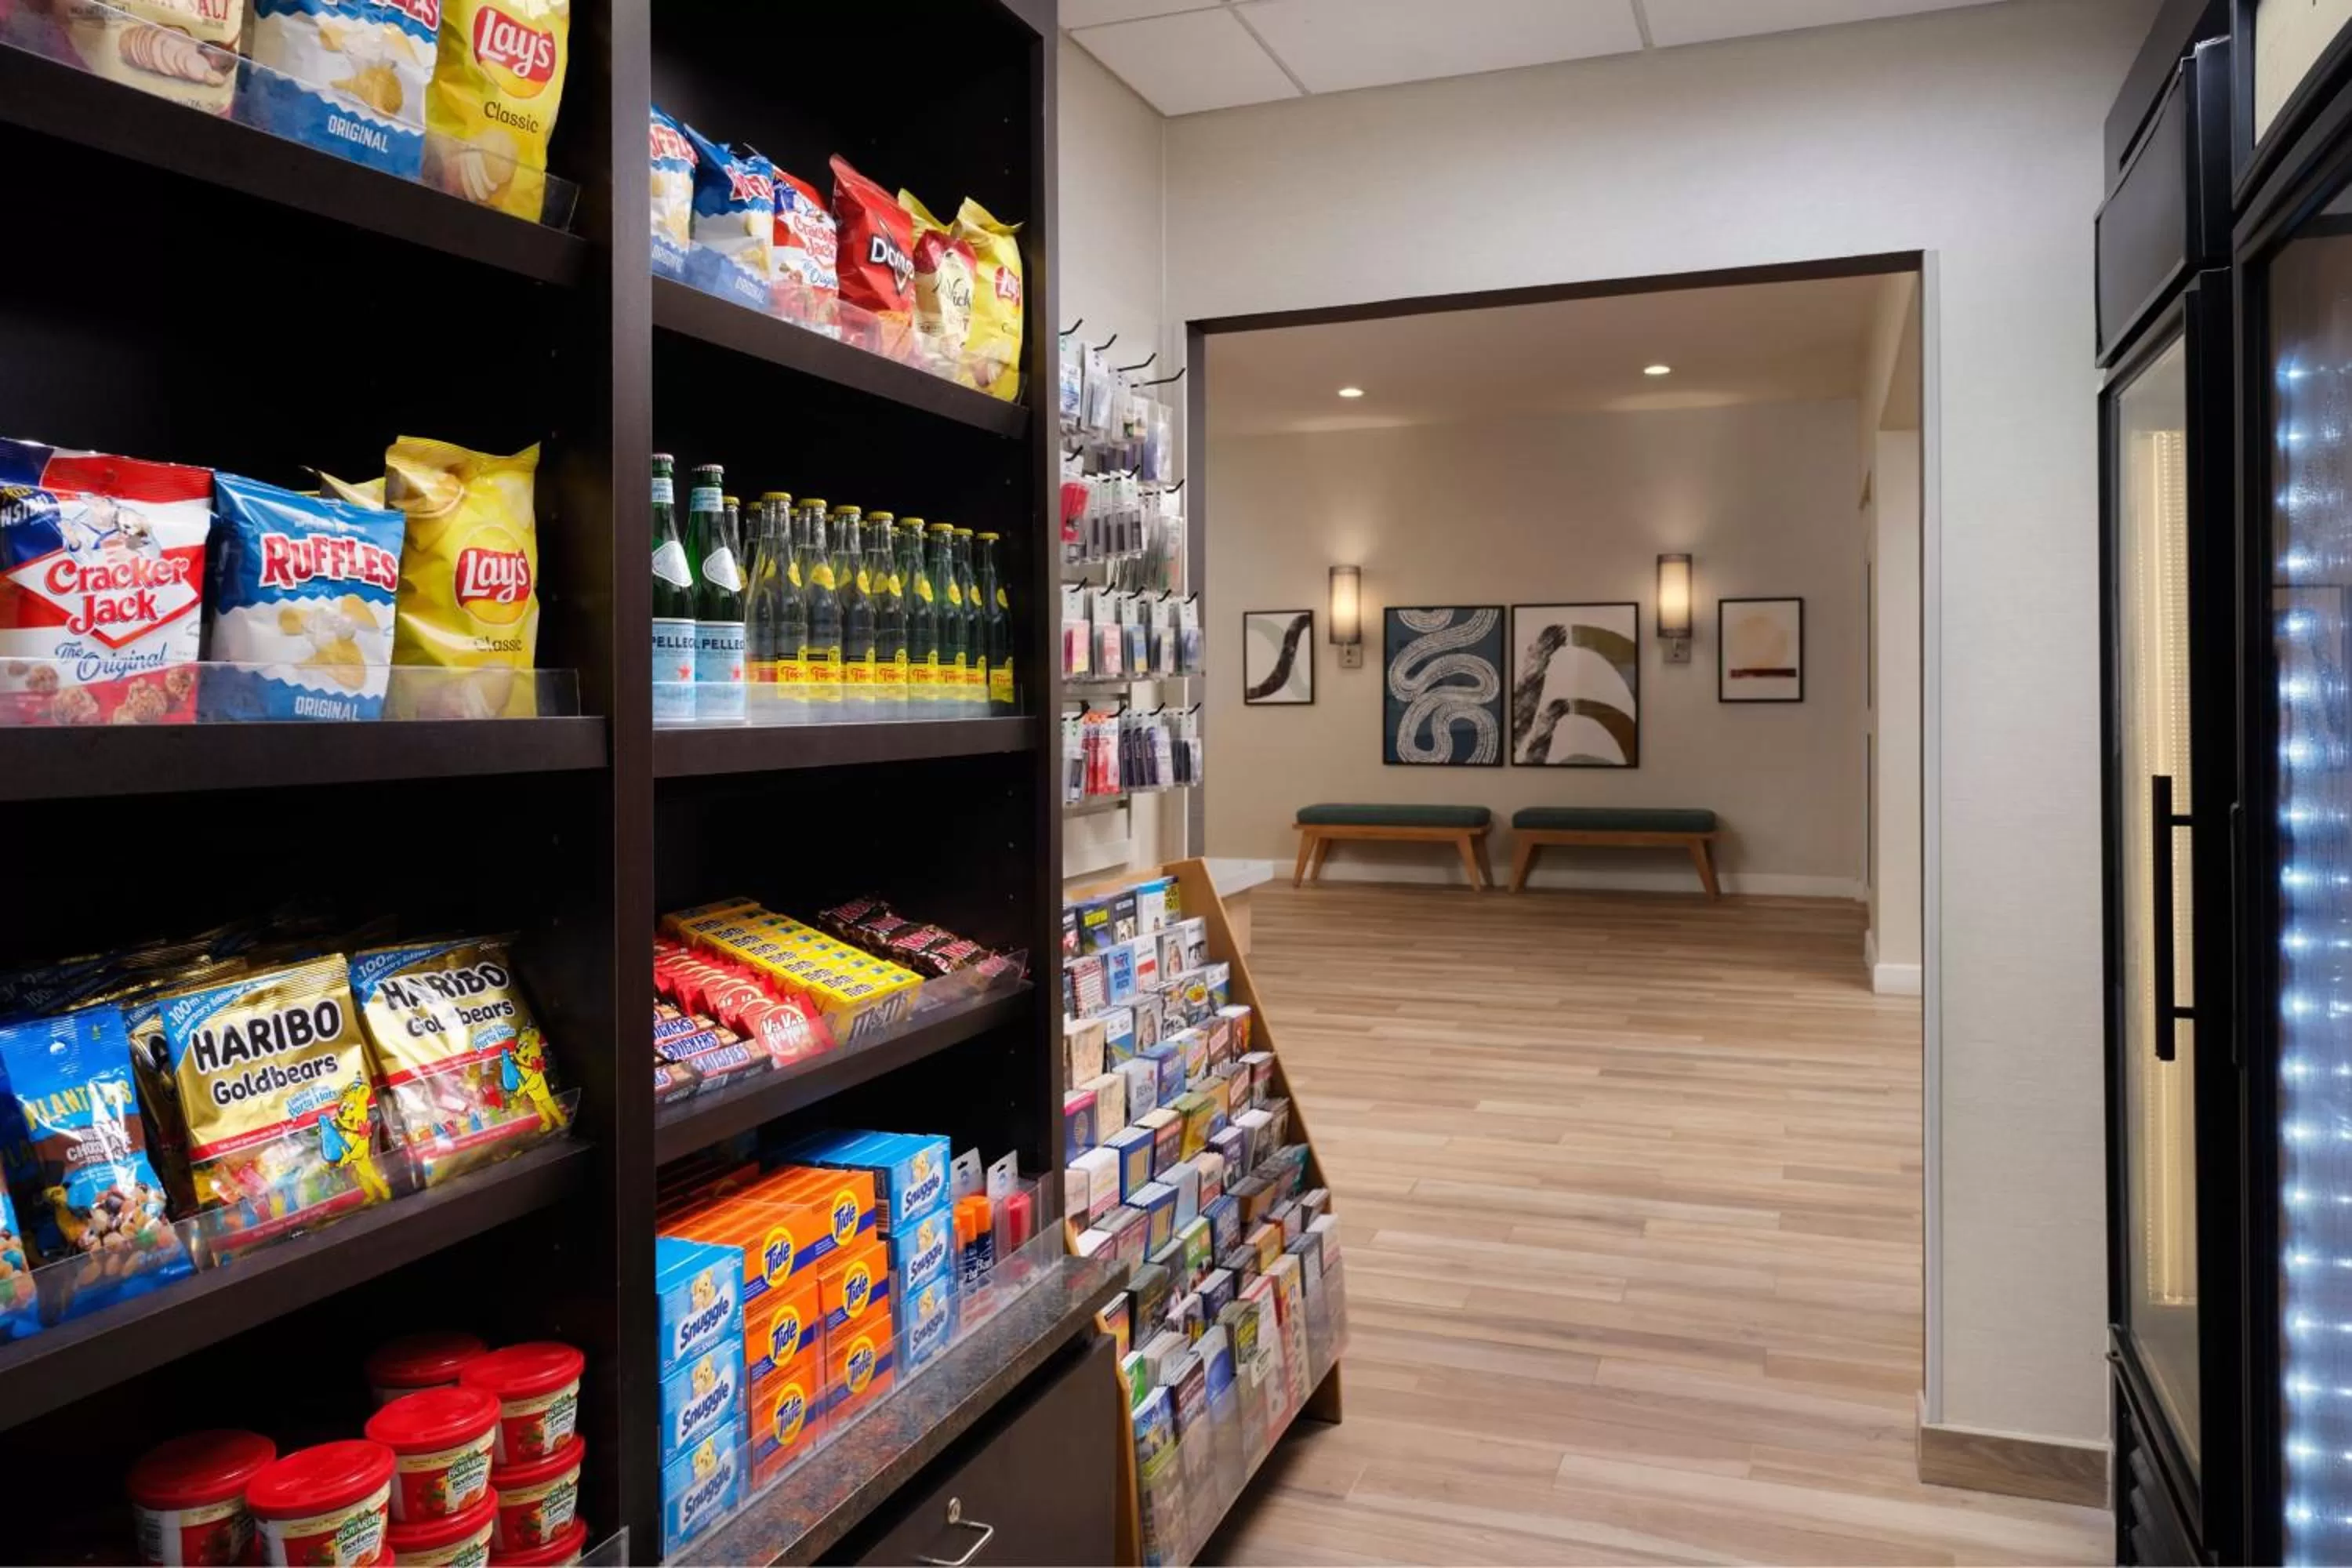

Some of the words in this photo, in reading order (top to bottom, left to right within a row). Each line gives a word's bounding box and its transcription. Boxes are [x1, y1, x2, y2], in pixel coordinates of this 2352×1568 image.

[478, 9, 553, 77] Lay's
[327, 114, 389, 153] ORIGINAL
[483, 101, 539, 134] Classic
[44, 557, 190, 596] Cracker
[259, 532, 399, 593] RUFFLES
[462, 549, 528, 603] Lay's
[66, 588, 159, 635] Jack
[55, 641, 84, 664] The
[76, 641, 168, 681] Original
[295, 696, 361, 722] ORIGINAL
[191, 1000, 342, 1073] HARIBO
[406, 1000, 514, 1037] Golbears
[661, 1031, 718, 1061] SNICKERS
[212, 1055, 339, 1105] Goldbears
[904, 1174, 940, 1212] Snuggle
[833, 1203, 857, 1241] Tide
[764, 1240, 791, 1280] Tide
[910, 1241, 943, 1282] Snuggle
[846, 1273, 869, 1313] Tide
[680, 1295, 729, 1350] Snuggle
[772, 1317, 798, 1359] Tide
[912, 1309, 945, 1351] Snuggle
[848, 1348, 873, 1389] Tide
[681, 1380, 729, 1437] Snuggle
[776, 1395, 803, 1438] Tide
[684, 1464, 731, 1523] Snuggle
